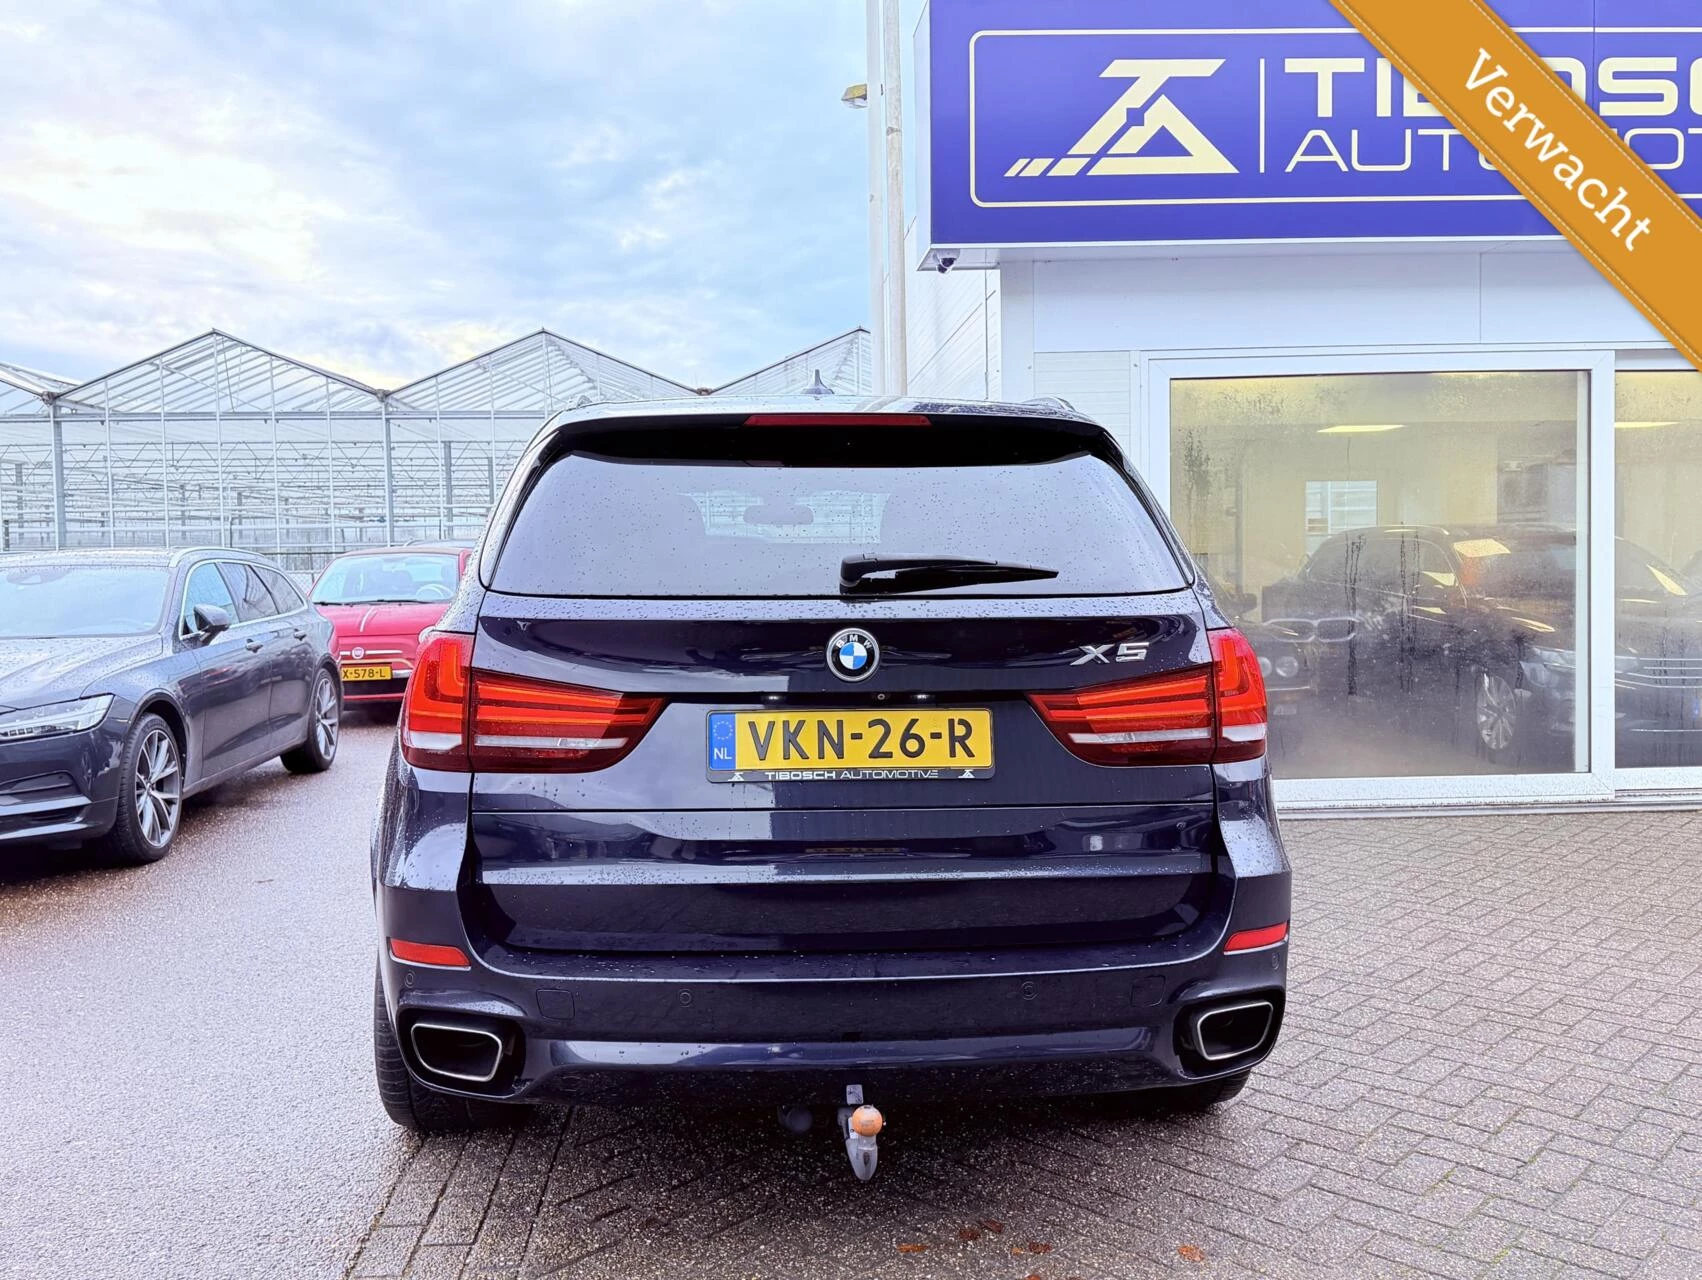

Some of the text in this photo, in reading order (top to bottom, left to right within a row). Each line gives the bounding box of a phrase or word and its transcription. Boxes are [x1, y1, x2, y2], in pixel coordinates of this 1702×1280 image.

[835, 634, 872, 649] BMW
[1069, 641, 1150, 666] X5
[342, 668, 386, 679] X-578-L
[748, 717, 976, 761] VKN-26-R
[713, 747, 732, 760] NL
[764, 769, 939, 780] TIBOSCH AUTOMOTIVE
